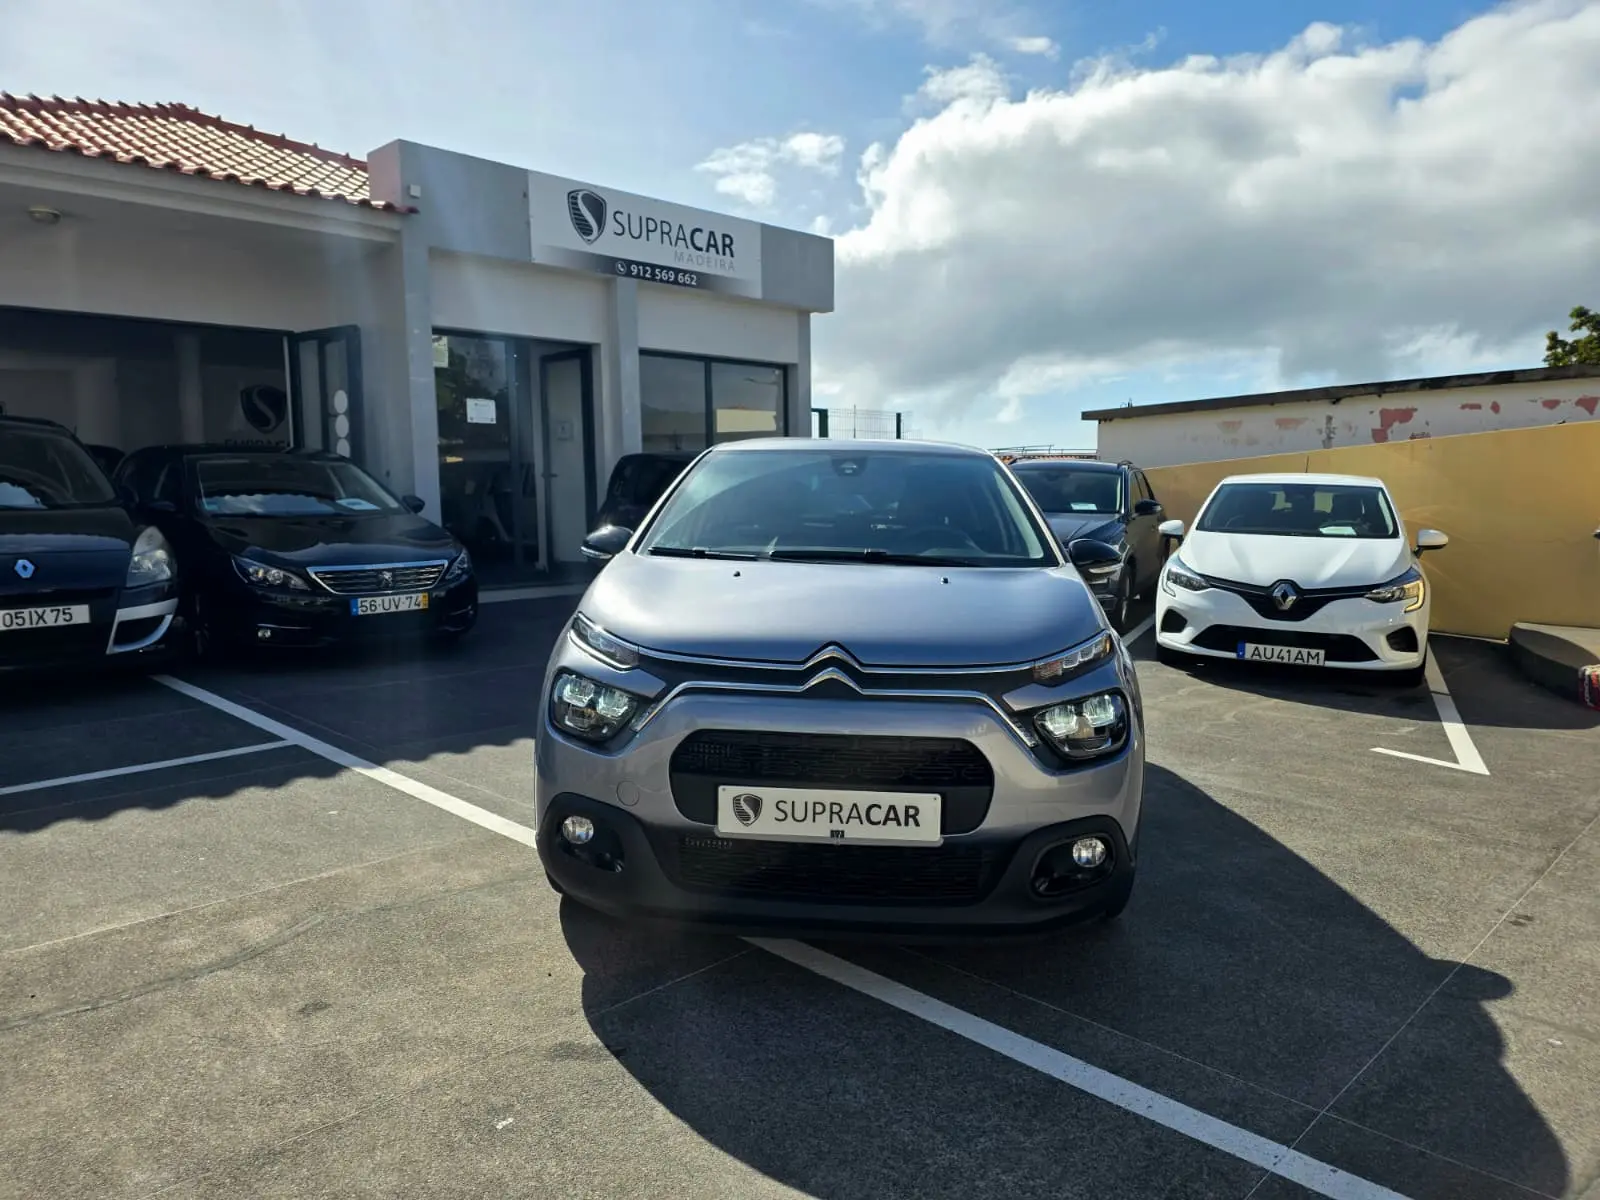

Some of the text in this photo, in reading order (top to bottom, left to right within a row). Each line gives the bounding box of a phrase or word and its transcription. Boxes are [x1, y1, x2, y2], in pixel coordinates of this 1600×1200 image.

[612, 210, 735, 258] SUPRACAR
[674, 250, 735, 272] MADEIRA
[630, 263, 697, 286] 912 569 662
[774, 799, 921, 828] SUPRACAR
